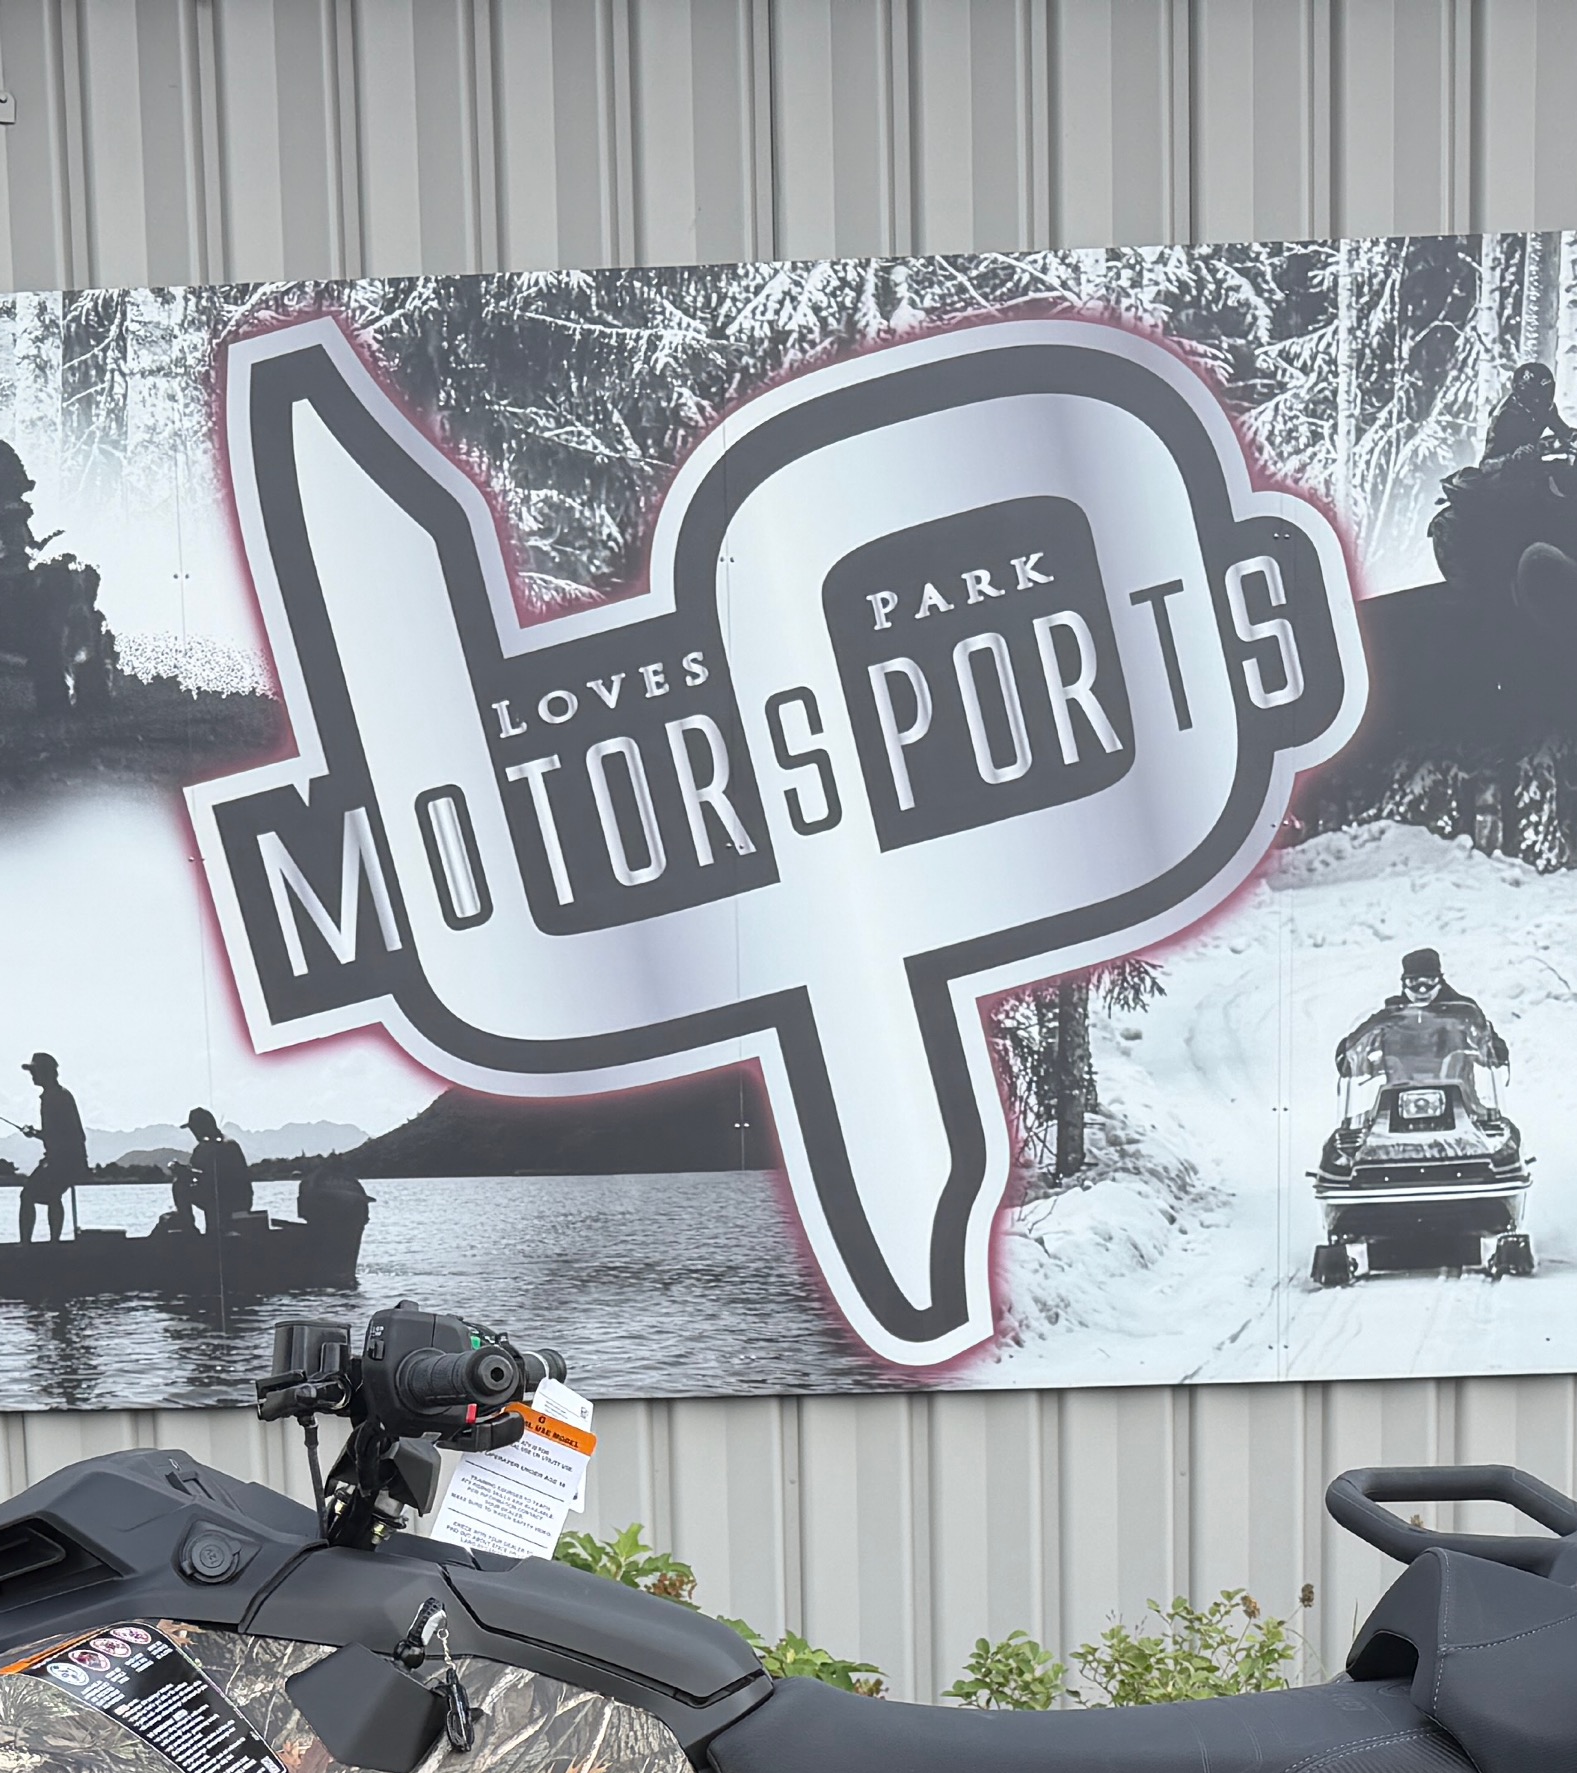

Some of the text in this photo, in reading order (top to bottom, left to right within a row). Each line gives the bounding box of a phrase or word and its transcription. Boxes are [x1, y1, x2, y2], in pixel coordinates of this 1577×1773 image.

[865, 551, 1054, 631] PARK
[491, 650, 712, 739] LOVES
[255, 553, 1303, 980] MOTORSPORTS
